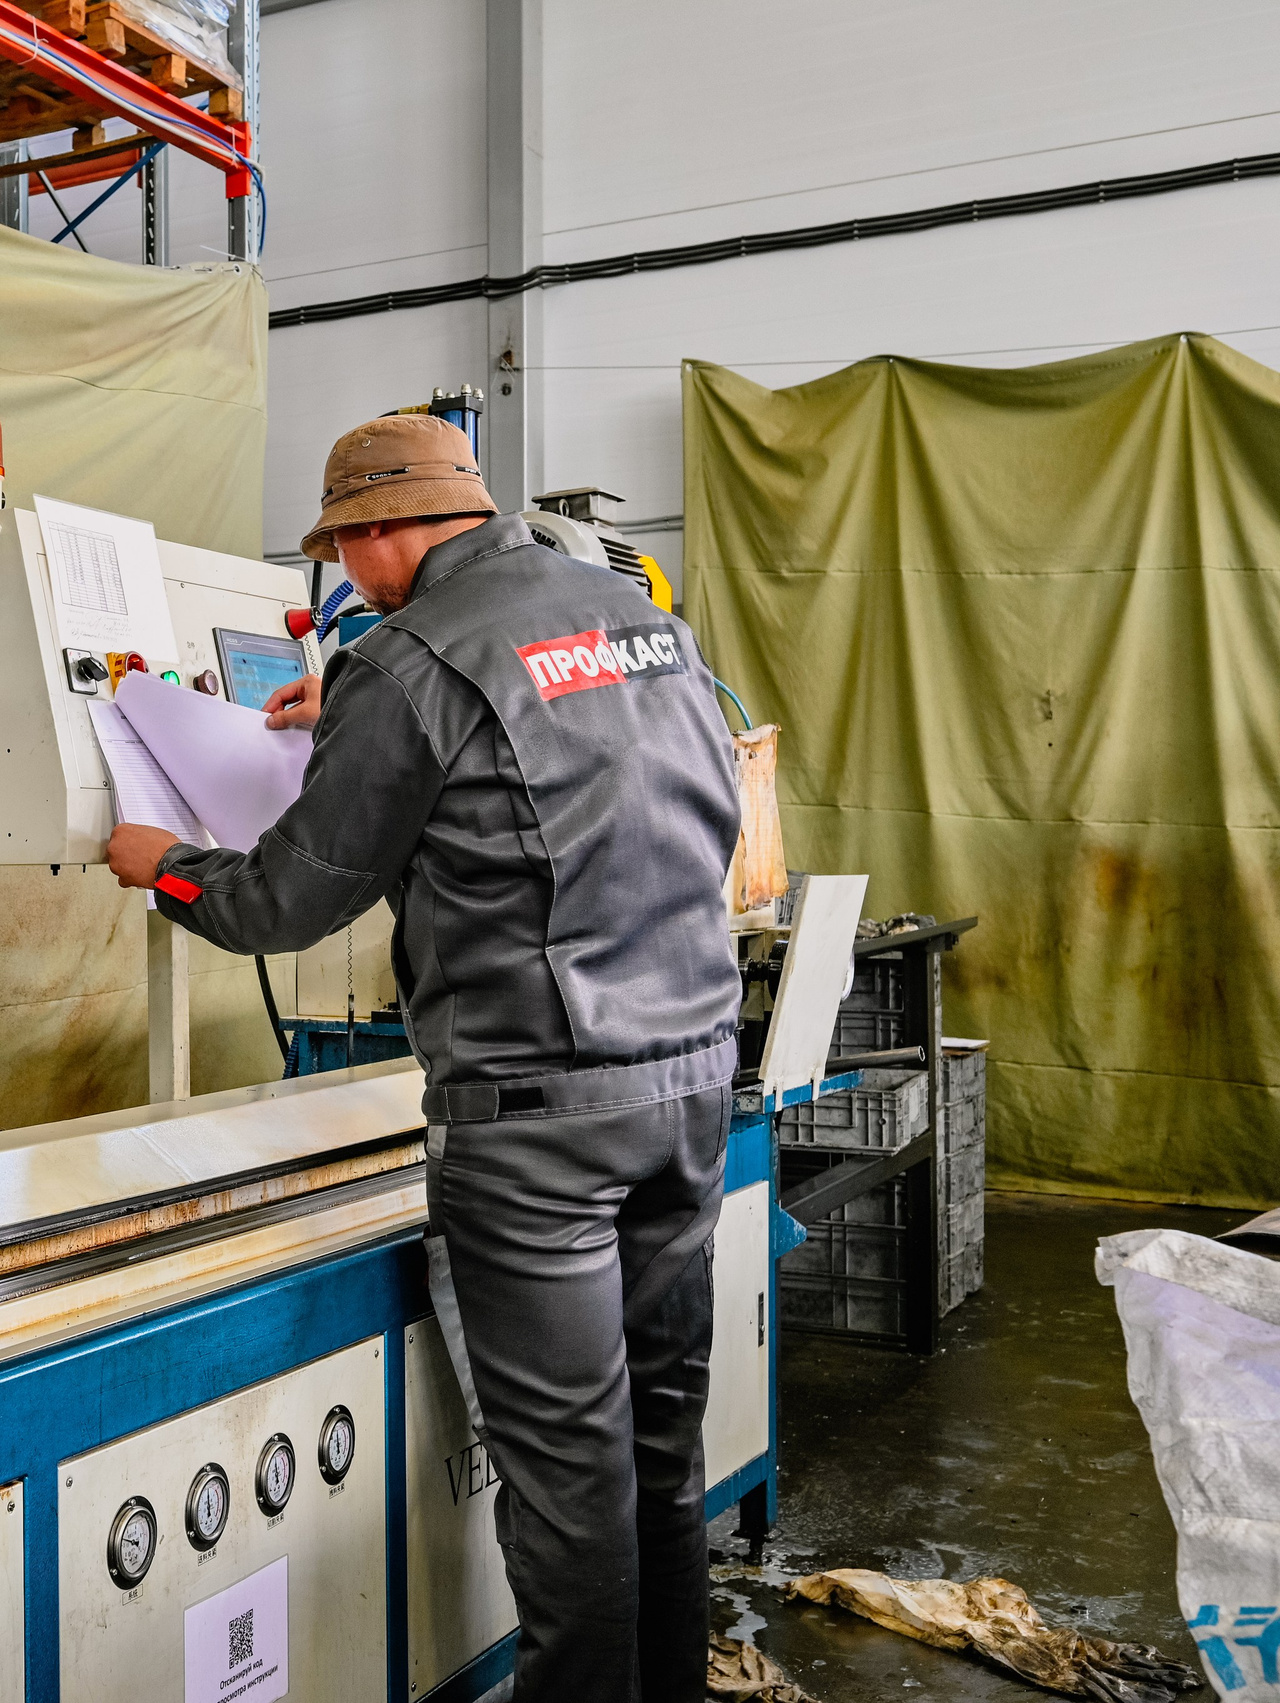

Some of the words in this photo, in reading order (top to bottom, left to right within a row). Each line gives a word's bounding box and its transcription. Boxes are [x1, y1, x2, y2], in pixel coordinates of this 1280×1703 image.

[526, 633, 680, 688] ПРОФКАСТ
[217, 1685, 246, 1703] осмотра
[247, 1665, 278, 1689] инструкции
[220, 1662, 252, 1690] Отсканируй
[253, 1659, 263, 1671] код
